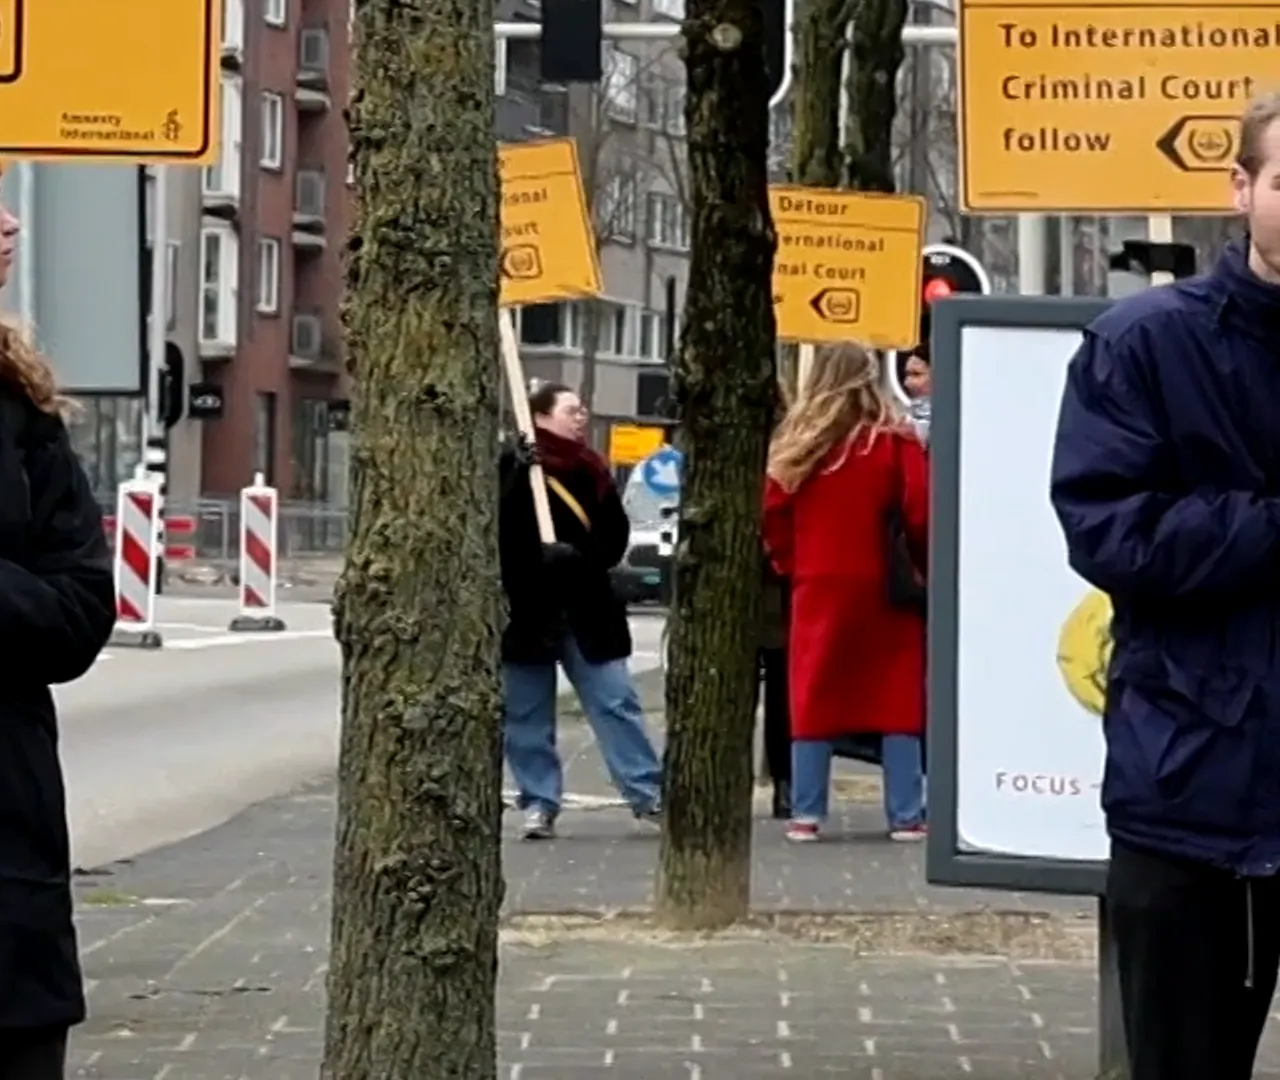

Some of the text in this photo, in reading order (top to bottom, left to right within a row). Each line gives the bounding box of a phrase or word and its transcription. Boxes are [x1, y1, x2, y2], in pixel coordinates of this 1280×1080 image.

[998, 23, 1280, 49] To International
[1001, 74, 1255, 101] Criminal Court
[1002, 127, 1111, 153] follow
[778, 196, 848, 216] Detour
[813, 263, 866, 281] Court
[995, 771, 1082, 796] FOCUS
